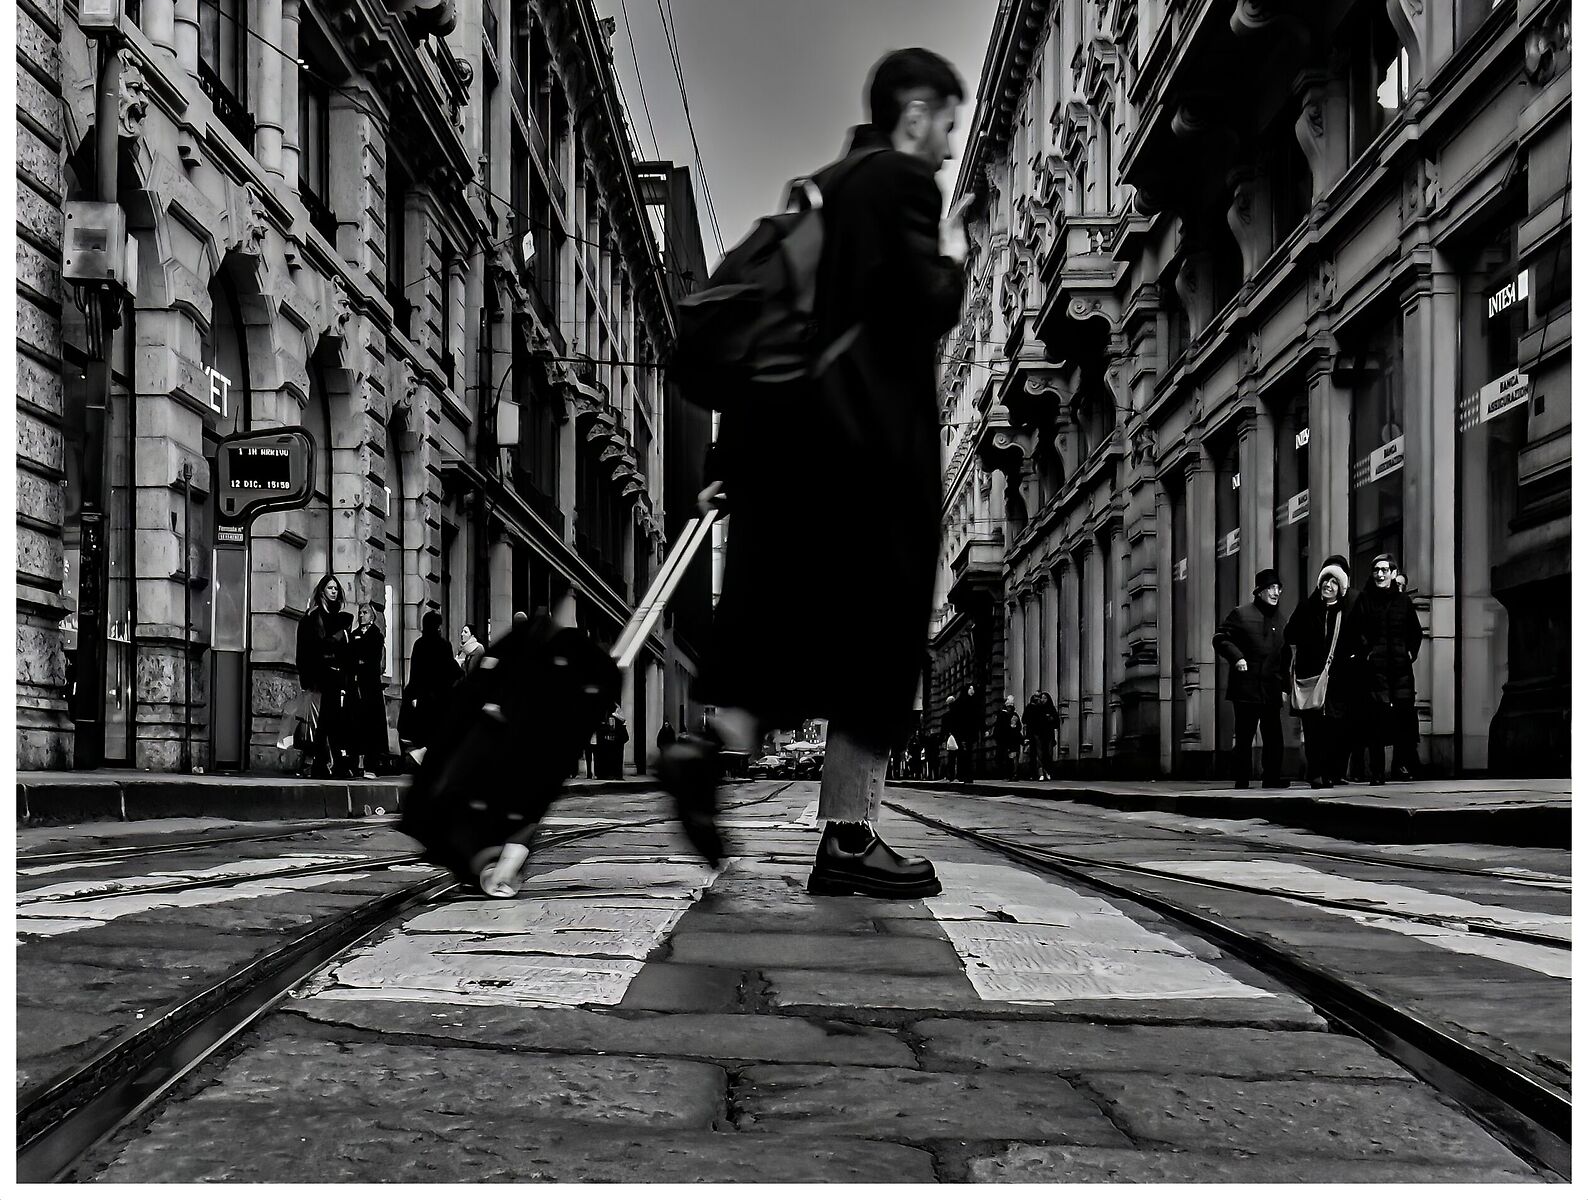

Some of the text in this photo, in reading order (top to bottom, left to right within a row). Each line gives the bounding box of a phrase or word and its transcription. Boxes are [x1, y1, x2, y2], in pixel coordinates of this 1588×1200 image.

[1488, 281, 1516, 319] INTESA
[1500, 375, 1519, 394] BANCA
[231, 480, 240, 488] 12
[243, 480, 262, 489] DIC.
